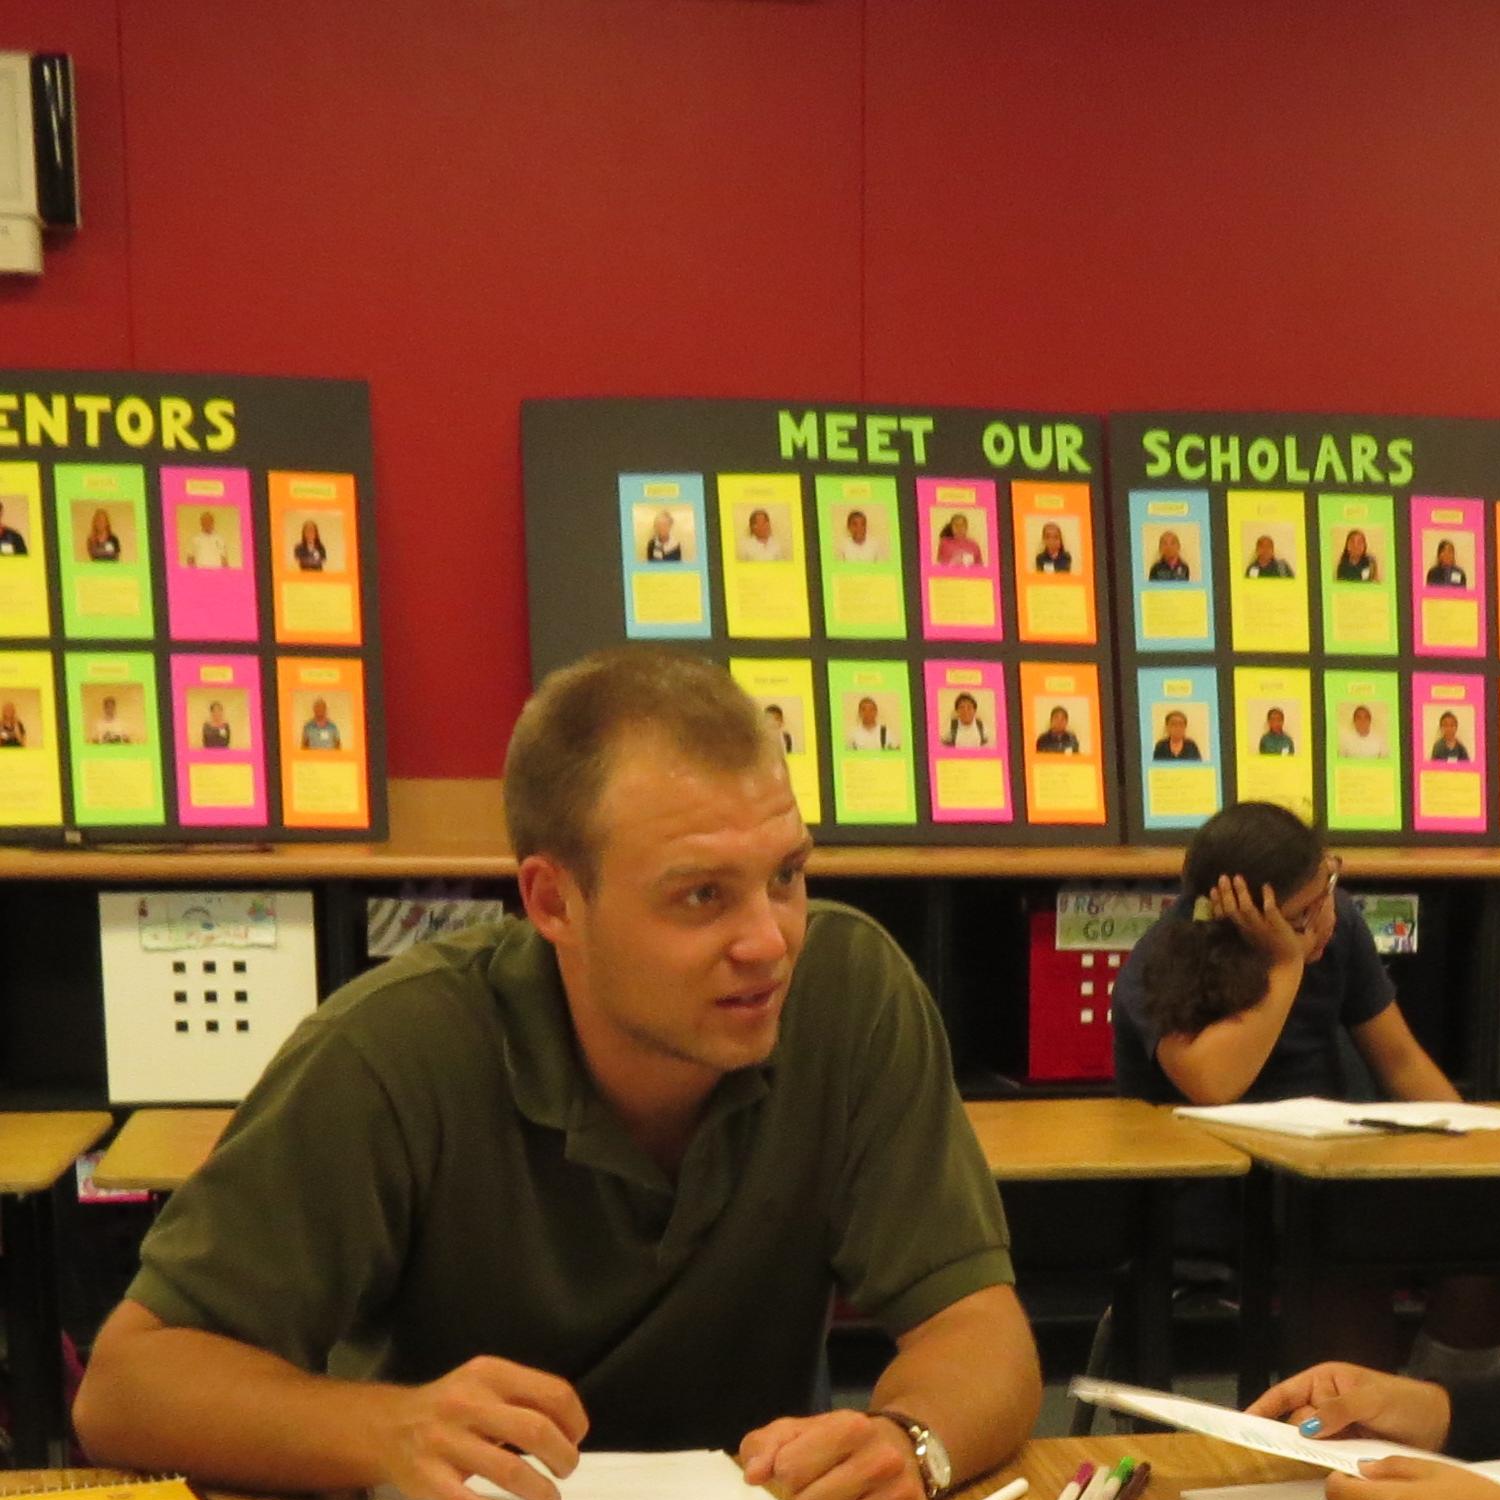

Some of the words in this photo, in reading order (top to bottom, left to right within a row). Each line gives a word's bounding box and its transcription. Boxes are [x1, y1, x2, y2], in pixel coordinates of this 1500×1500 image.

[779, 410, 934, 466] MEET
[983, 420, 1092, 474] OUR
[1142, 428, 1414, 487] SCHOLARS
